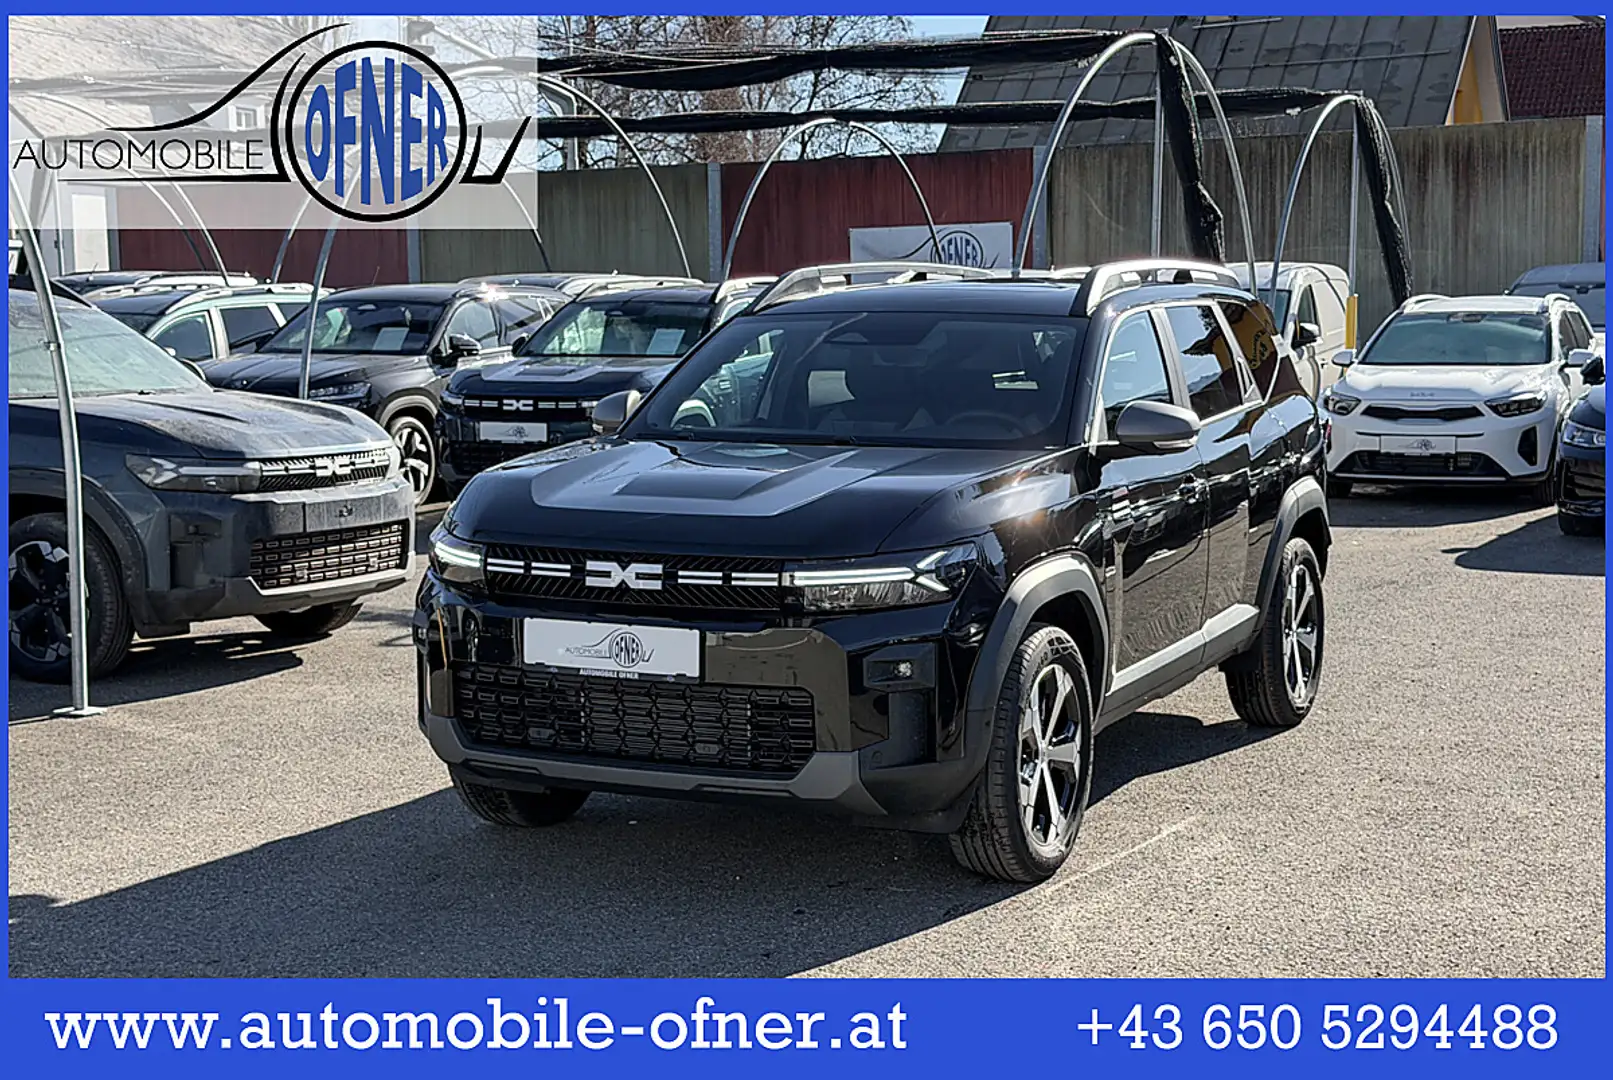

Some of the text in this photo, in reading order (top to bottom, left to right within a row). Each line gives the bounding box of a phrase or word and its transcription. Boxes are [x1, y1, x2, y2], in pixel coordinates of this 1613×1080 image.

[614, 635, 640, 665] OFNER
[579, 667, 640, 679] AUTOMOBILE OFNER
